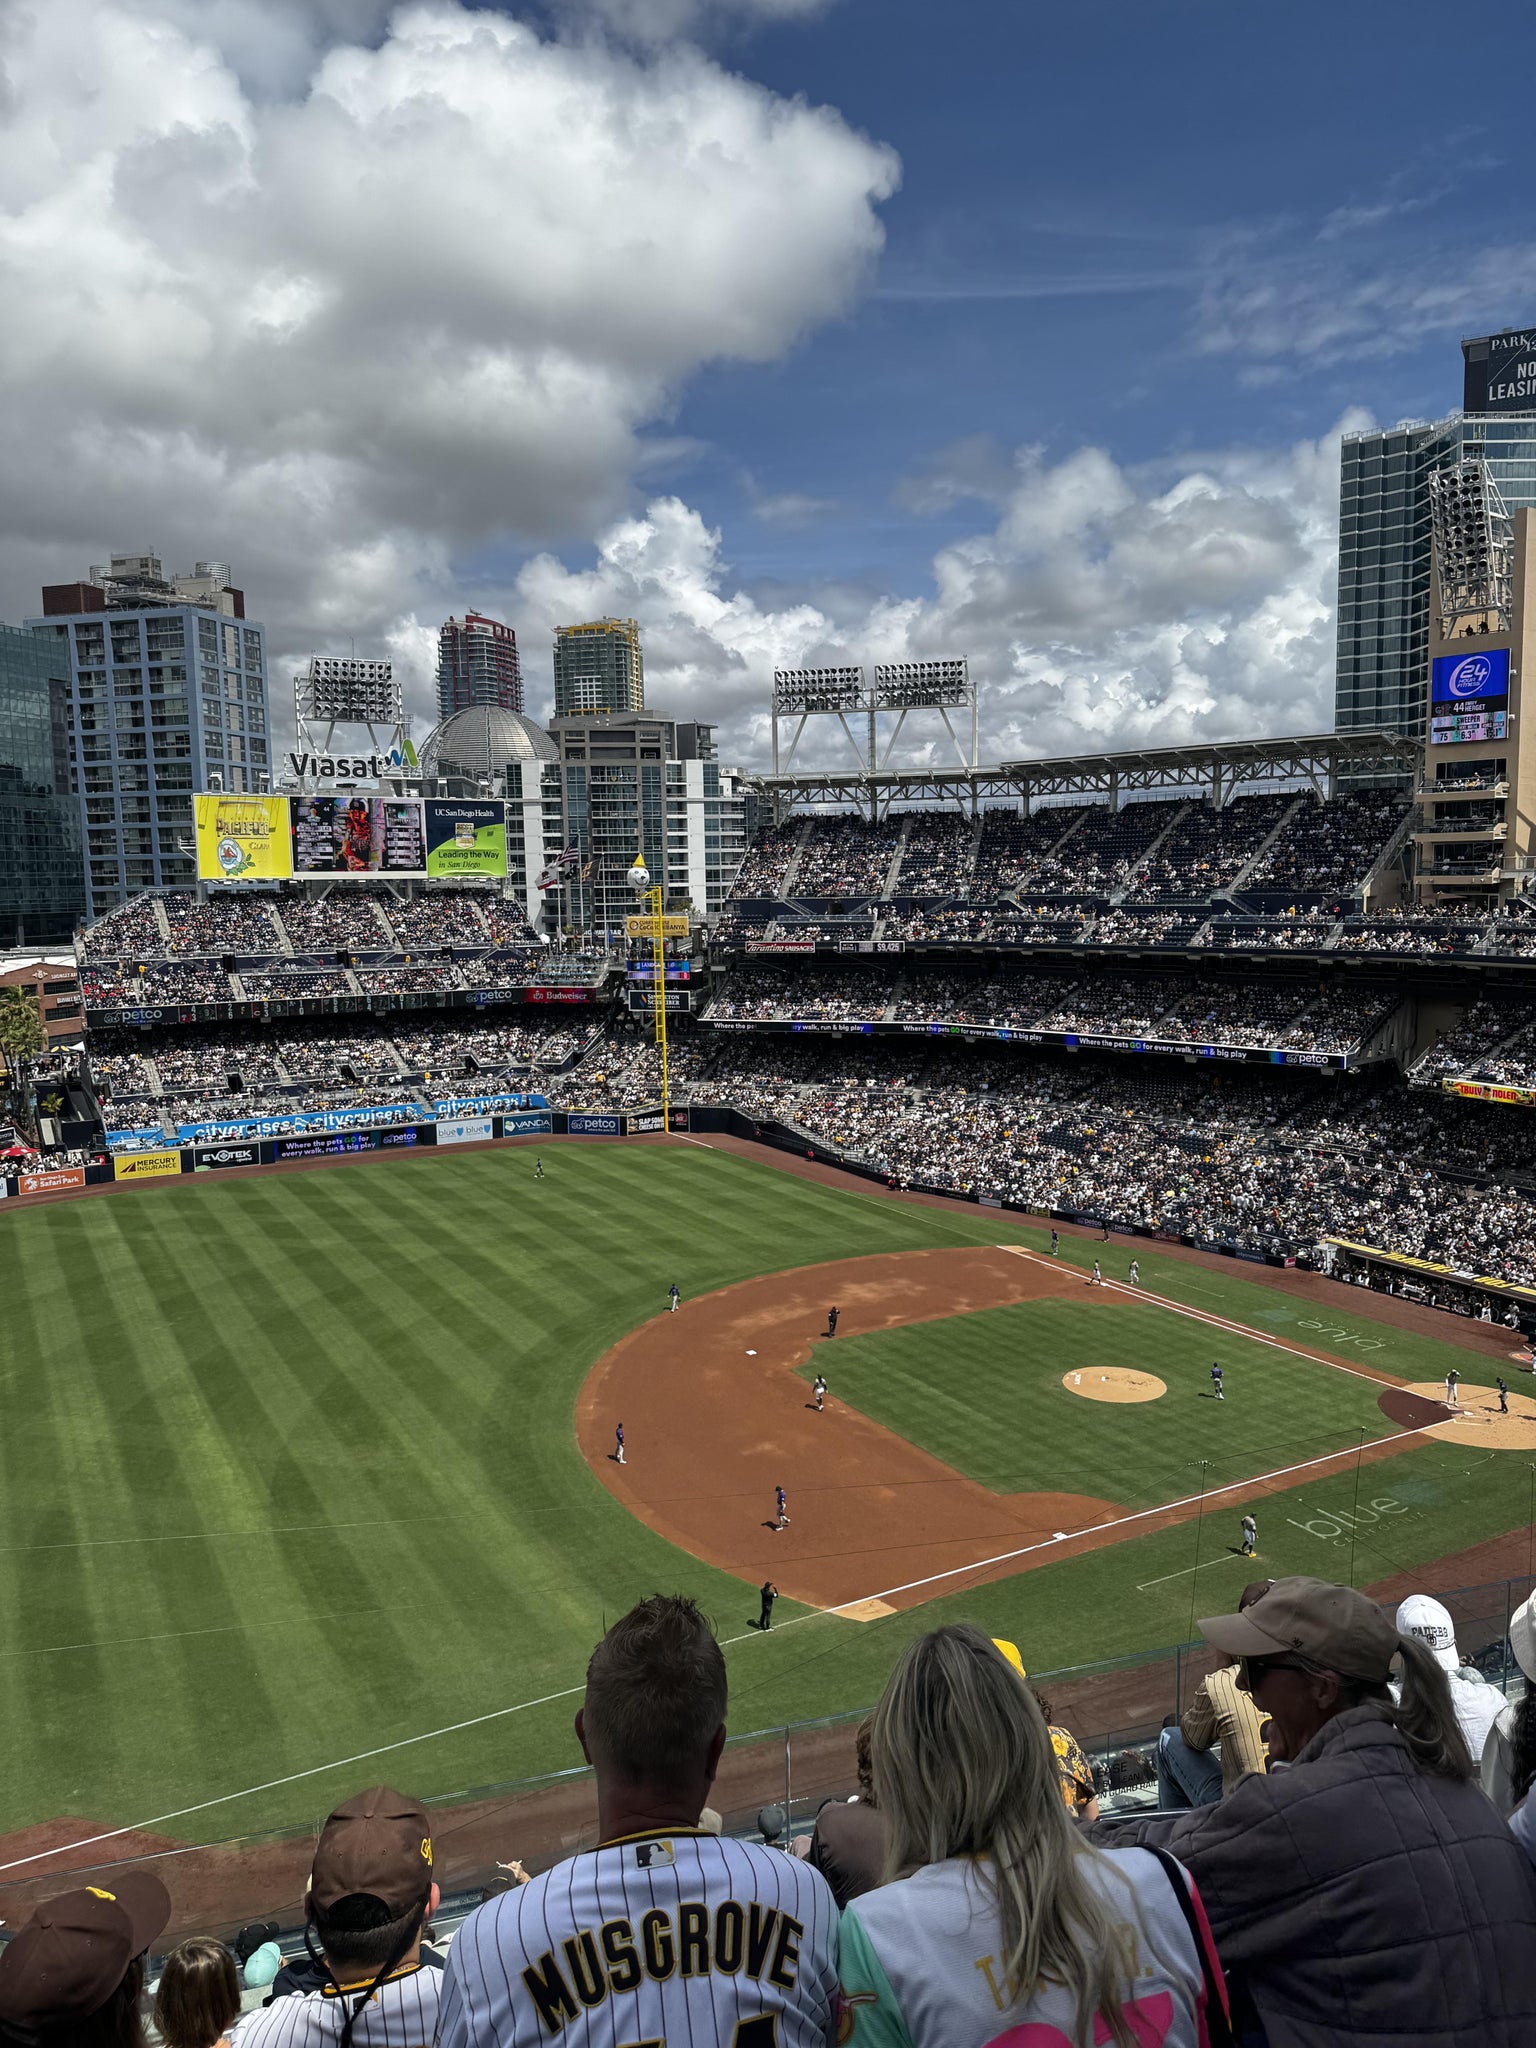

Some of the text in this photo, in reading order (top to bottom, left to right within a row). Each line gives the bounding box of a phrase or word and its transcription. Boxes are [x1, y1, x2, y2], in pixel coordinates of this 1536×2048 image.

[1491, 334, 1528, 350] PARK
[1460, 664, 1488, 681] 24
[1453, 703, 1464, 713] 44
[1456, 715, 1481, 724] SWEEPER
[289, 753, 384, 779] Viasat
[435, 808, 495, 818] UC San Diego Health
[438, 851, 500, 860] Leading the Way
[439, 860, 446, 868] in
[462, 861, 481, 869] Diego
[748, 943, 784, 952] Tarantino
[877, 943, 900, 952] $9,425
[480, 990, 512, 1002] petco
[546, 991, 587, 1000] Budweiser
[122, 1009, 163, 1021] petco
[838, 1024, 850, 1032] big
[986, 1029, 1002, 1037] walk,
[1019, 1032, 1029, 1040] big
[1029, 1033, 1043, 1041] play
[1079, 1037, 1101, 1045] Where
[1113, 1041, 1128, 1049] pets
[1154, 1045, 1173, 1053] every
[1175, 1046, 1194, 1054] walk,
[1209, 1048, 1216, 1056] &
[1216, 1049, 1229, 1058] big
[1230, 1050, 1247, 1059] play
[1299, 1053, 1329, 1065] petco
[1460, 1085, 1517, 1101] TRULY NOLEN
[515, 1120, 551, 1128] VANDA
[584, 1118, 616, 1130] petco
[466, 1126, 484, 1135] blue
[286, 1141, 312, 1150] Where
[326, 1138, 343, 1147] pets
[358, 1135, 369, 1143] for
[394, 1132, 417, 1142] petco
[281, 1149, 303, 1158] every
[304, 1148, 325, 1156] walk,
[347, 1142, 359, 1151] big
[359, 1141, 376, 1150] play
[137, 1156, 176, 1166] MERCURY
[202, 1149, 252, 1162] EVOTEK
[137, 1162, 177, 1172] INSURANCE
[40, 1177, 80, 1188] Safari Park
[1084, 1218, 1101, 1227] petco
[1114, 1224, 1133, 1233] petco
[1286, 1498, 1409, 1540] blue
[1108, 1784, 1139, 1797] GUARD
[1140, 1780, 1159, 1789] RAIL
[521, 1899, 804, 2036] MUSGROVE
